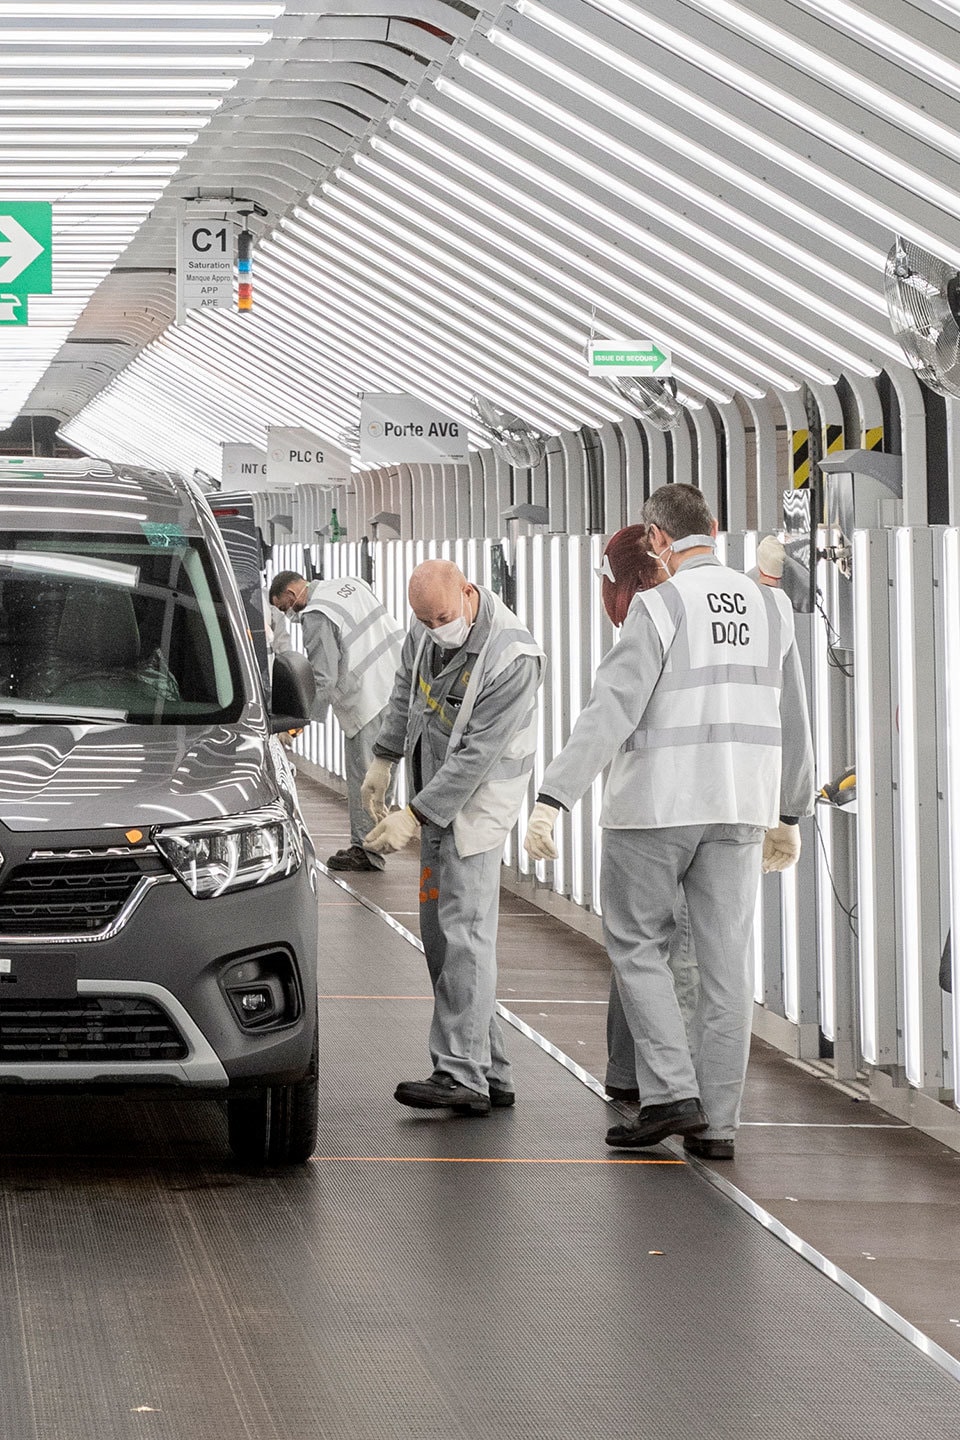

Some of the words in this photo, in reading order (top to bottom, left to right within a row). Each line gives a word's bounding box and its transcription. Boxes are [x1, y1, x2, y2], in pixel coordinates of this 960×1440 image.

[192, 228, 226, 252] C1
[188, 261, 230, 269] Saturation
[186, 274, 210, 282] Manque
[384, 422, 423, 437] Porte
[428, 422, 459, 437] AVG
[289, 450, 312, 462] PLC
[315, 451, 324, 463] G
[241, 463, 259, 474] INT
[336, 583, 356, 599] CSC
[706, 592, 747, 615] CSC
[711, 621, 750, 646] DQC
